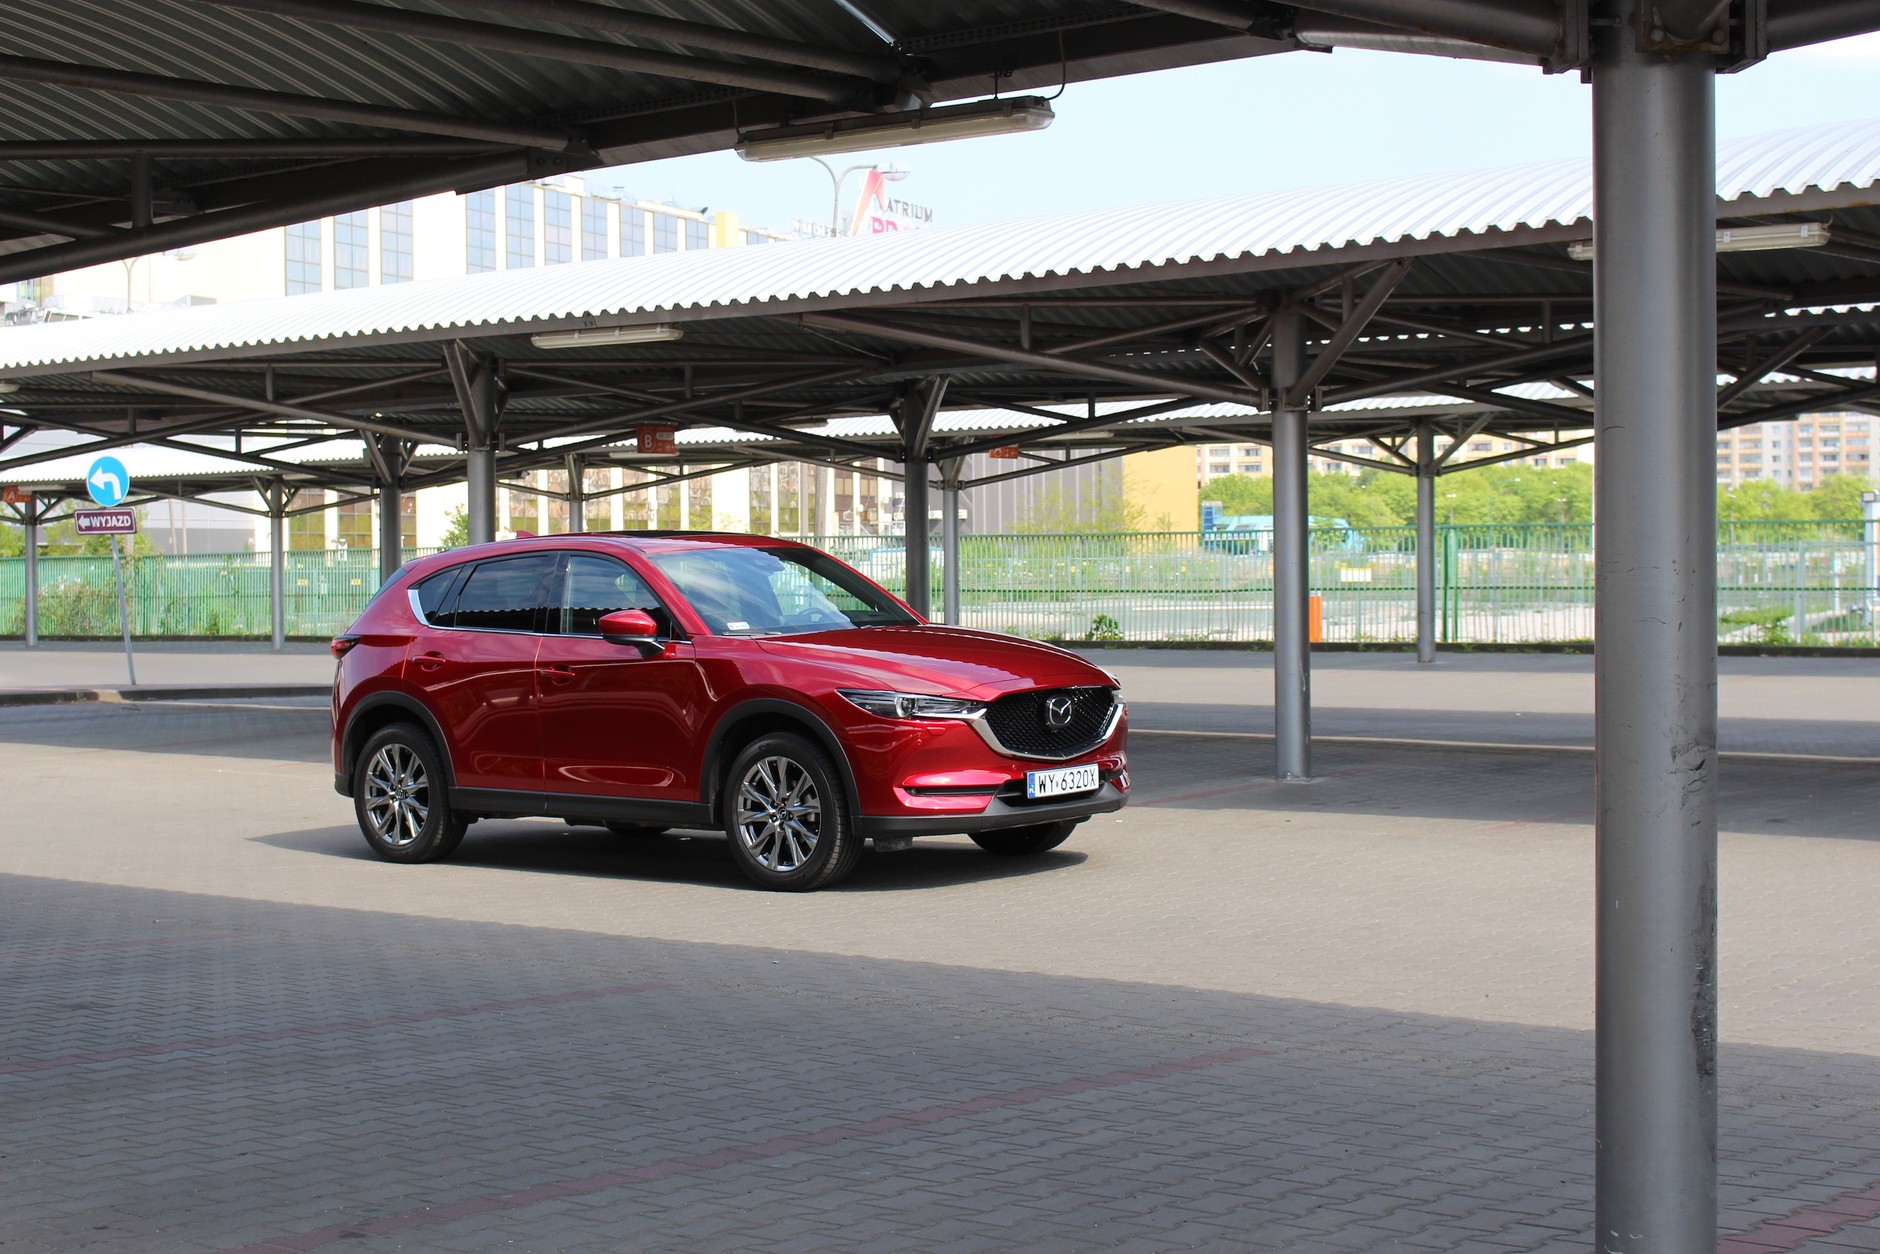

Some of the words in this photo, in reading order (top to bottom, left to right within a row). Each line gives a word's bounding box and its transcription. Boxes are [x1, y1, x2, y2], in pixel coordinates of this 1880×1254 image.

[887, 198, 933, 223] ATRIUM
[644, 434, 653, 449] B
[8, 490, 16, 500] A
[90, 515, 132, 528] WYJAZD
[1038, 773, 1056, 794] WY
[1060, 768, 1096, 791] 6320X
